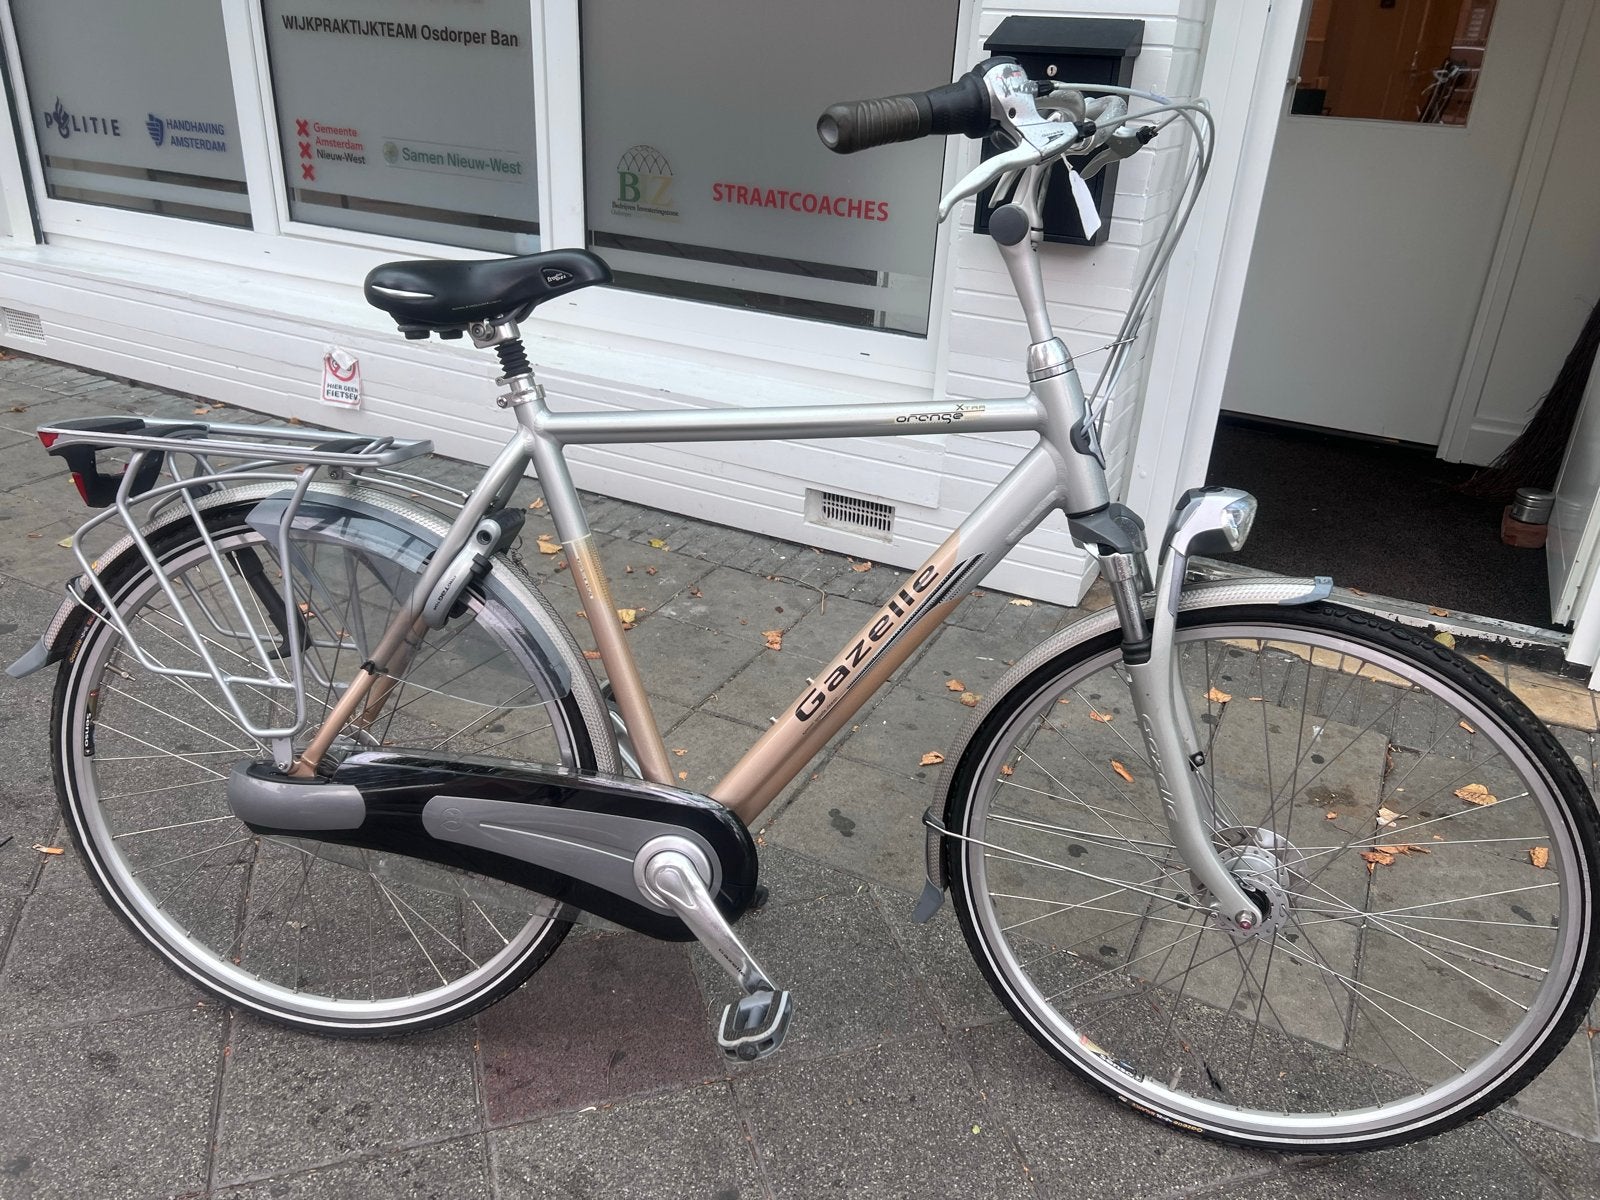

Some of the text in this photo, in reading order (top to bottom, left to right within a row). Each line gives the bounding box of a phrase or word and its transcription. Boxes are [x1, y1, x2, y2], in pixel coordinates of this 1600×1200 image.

[282, 15, 518, 47] WIJKPRAKTIJKTEAM Osdorper Ban
[44, 111, 121, 139] POLITIE
[166, 118, 225, 135] HANDHAVING
[313, 122, 357, 137] Gemeente
[170, 137, 226, 152] AMSTERDAM
[316, 136, 363, 150] Amsterdam
[317, 148, 366, 165] Nieuw-West
[402, 147, 522, 175] Samen Nieuw-West
[712, 183, 889, 222] STRAATCOACHES
[896, 412, 963, 424] orange
[795, 565, 939, 721] Gazelle
